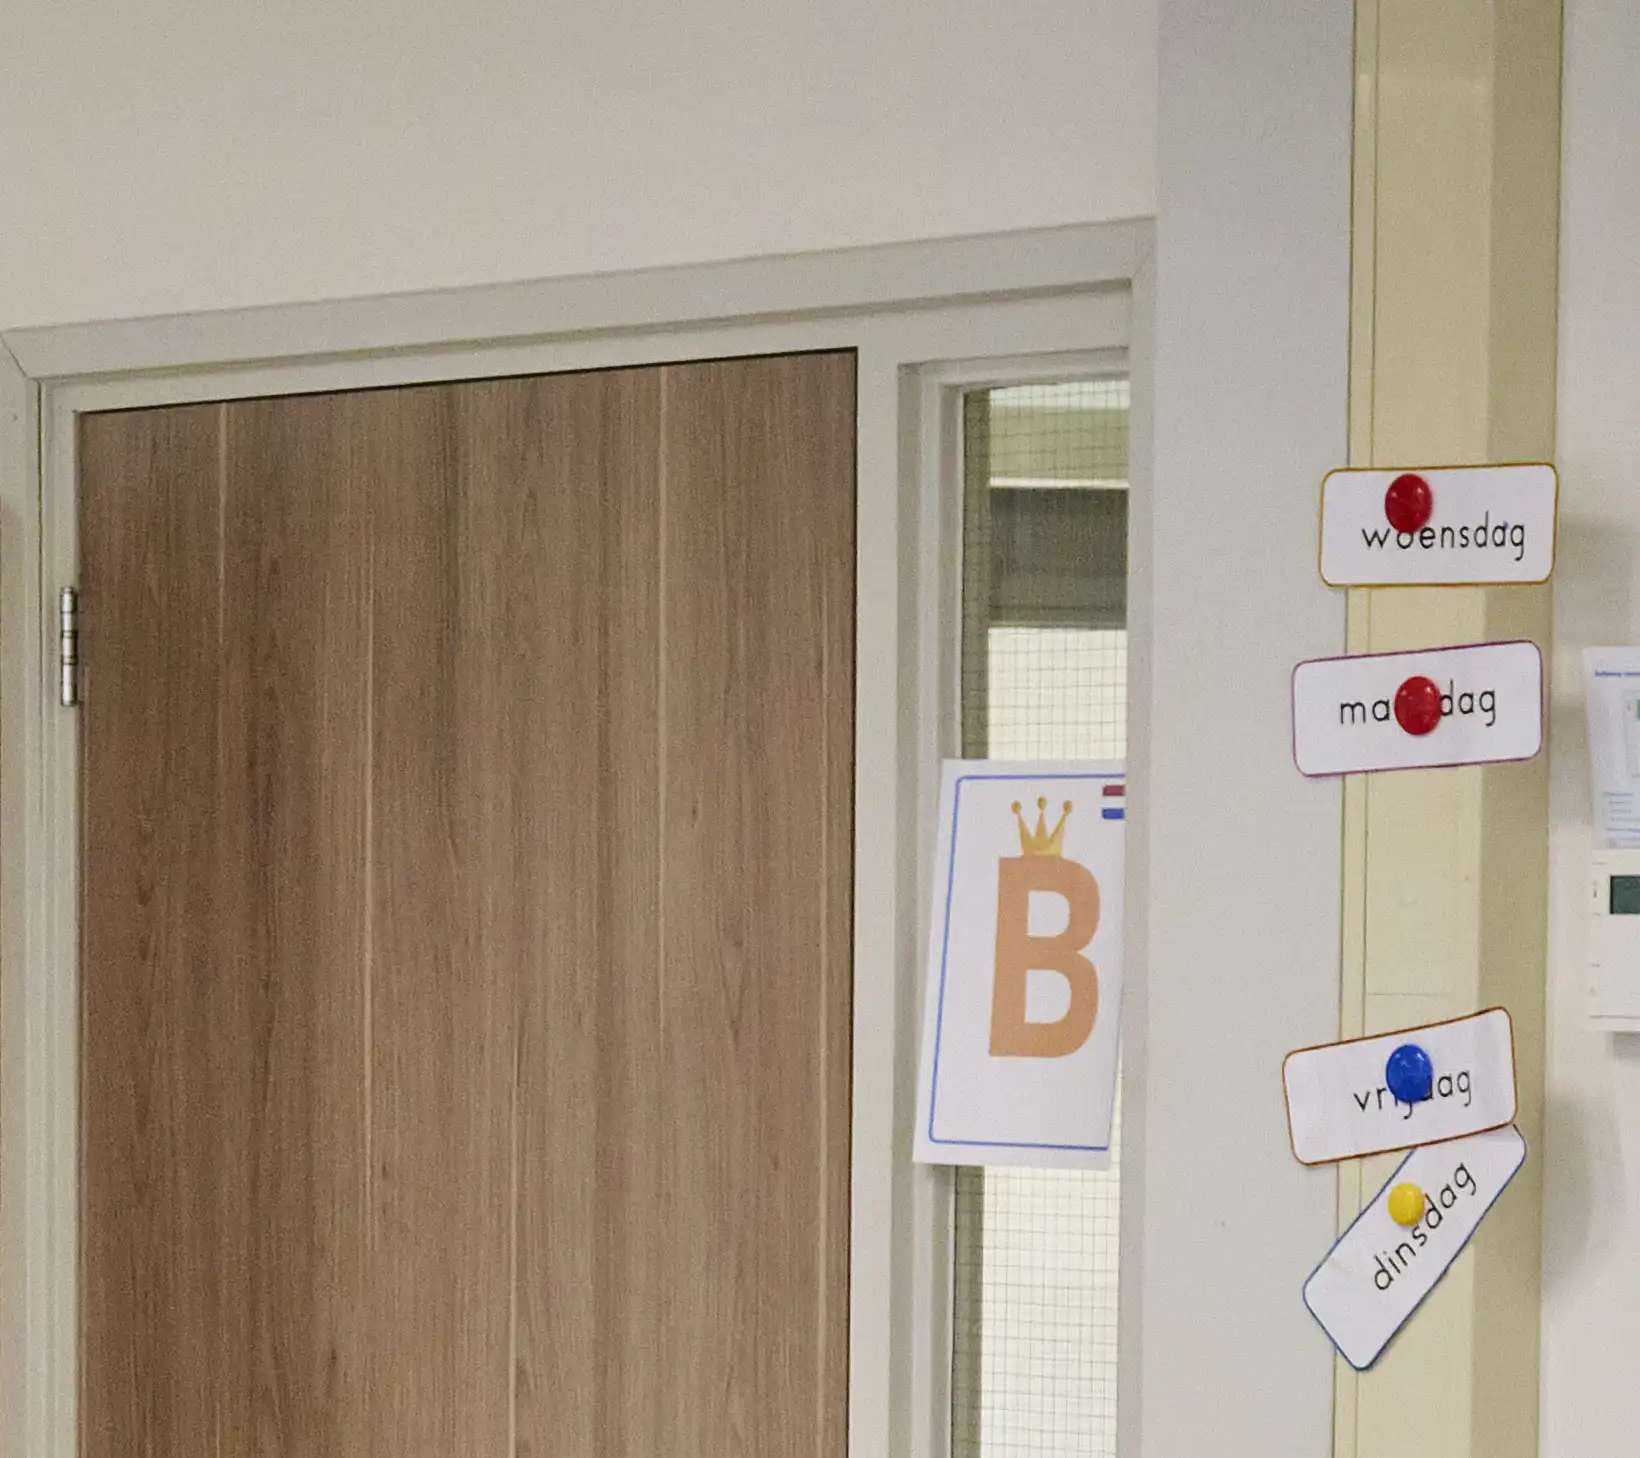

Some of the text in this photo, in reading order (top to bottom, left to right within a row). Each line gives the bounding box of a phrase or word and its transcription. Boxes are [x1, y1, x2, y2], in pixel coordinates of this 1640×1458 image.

[1361, 510, 1525, 562] woensdag
[1340, 679, 1497, 727] madag
[988, 855, 1101, 1059] B
[1373, 1162, 1477, 1291] dinsdag
